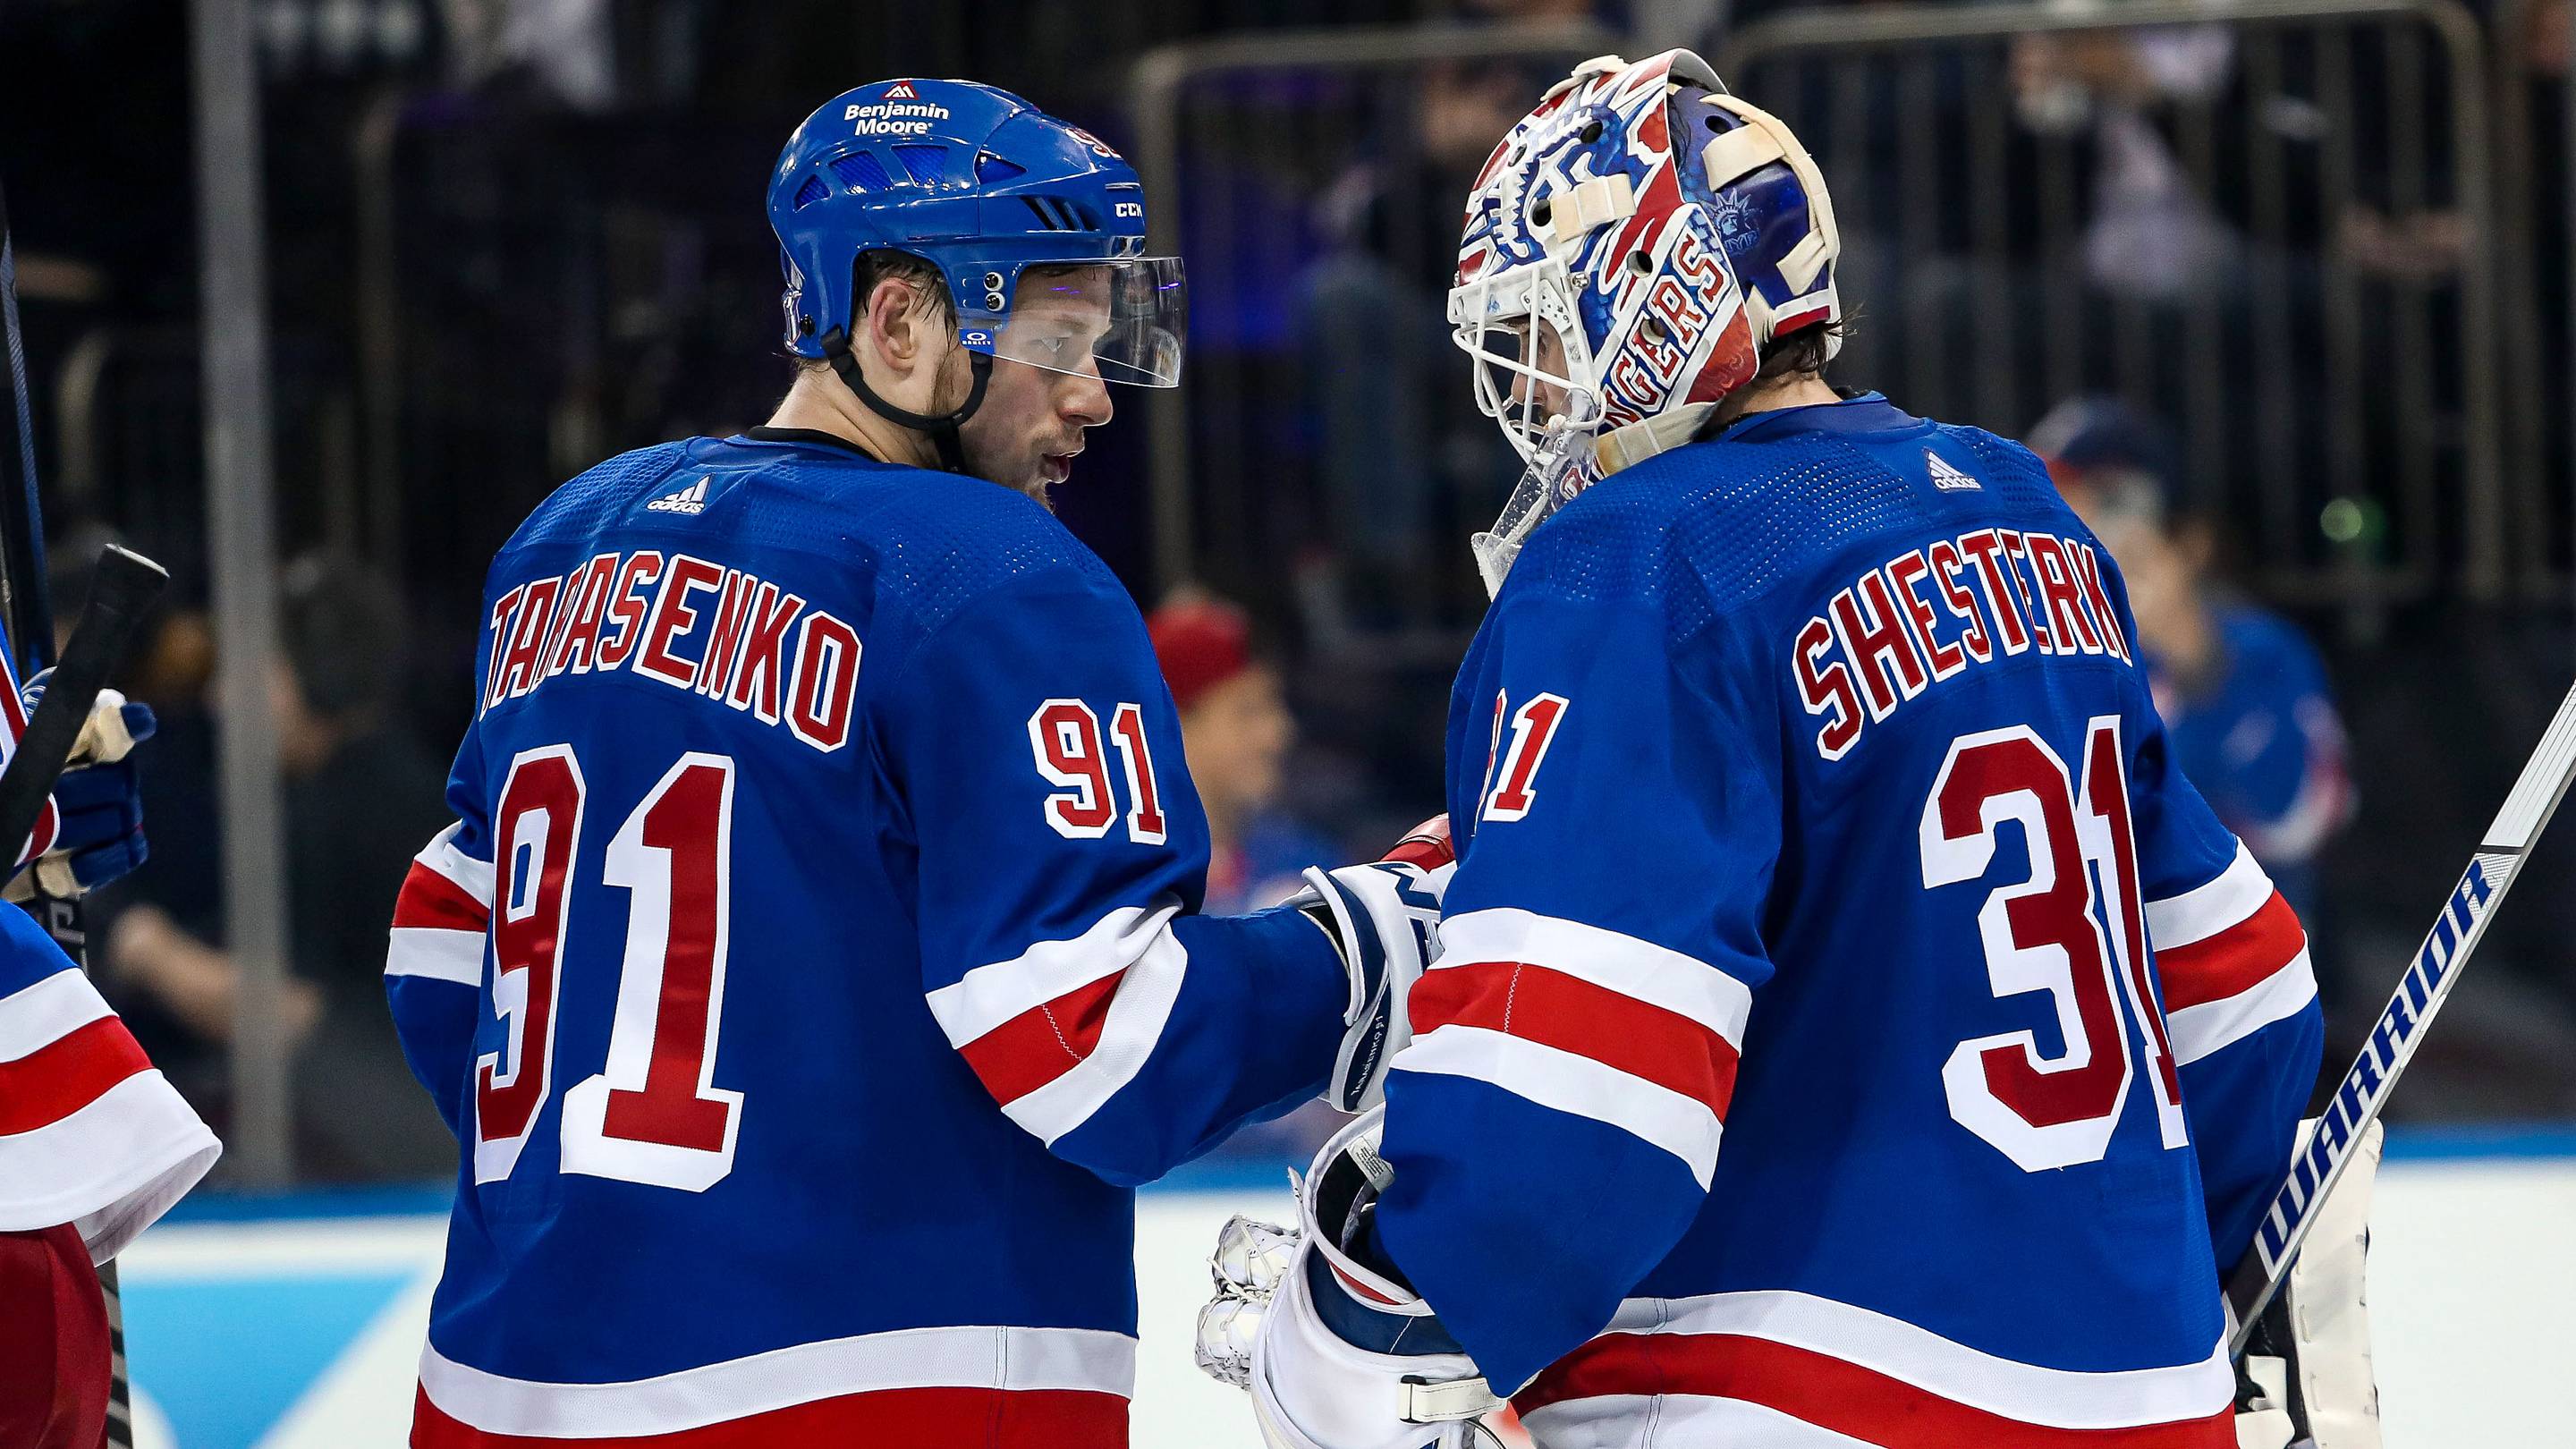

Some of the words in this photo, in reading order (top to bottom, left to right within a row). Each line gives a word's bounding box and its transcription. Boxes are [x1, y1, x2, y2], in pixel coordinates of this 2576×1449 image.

[843, 101, 949, 121] Benjamin
[854, 118, 928, 136] Moore
[647, 497, 705, 514] adidas
[1934, 475, 1981, 489] adidas
[1027, 698, 1167, 846] 91
[473, 742, 745, 1193] 91
[1919, 714, 2190, 1174] 31
[2258, 859, 2494, 1267] WARRIOR
